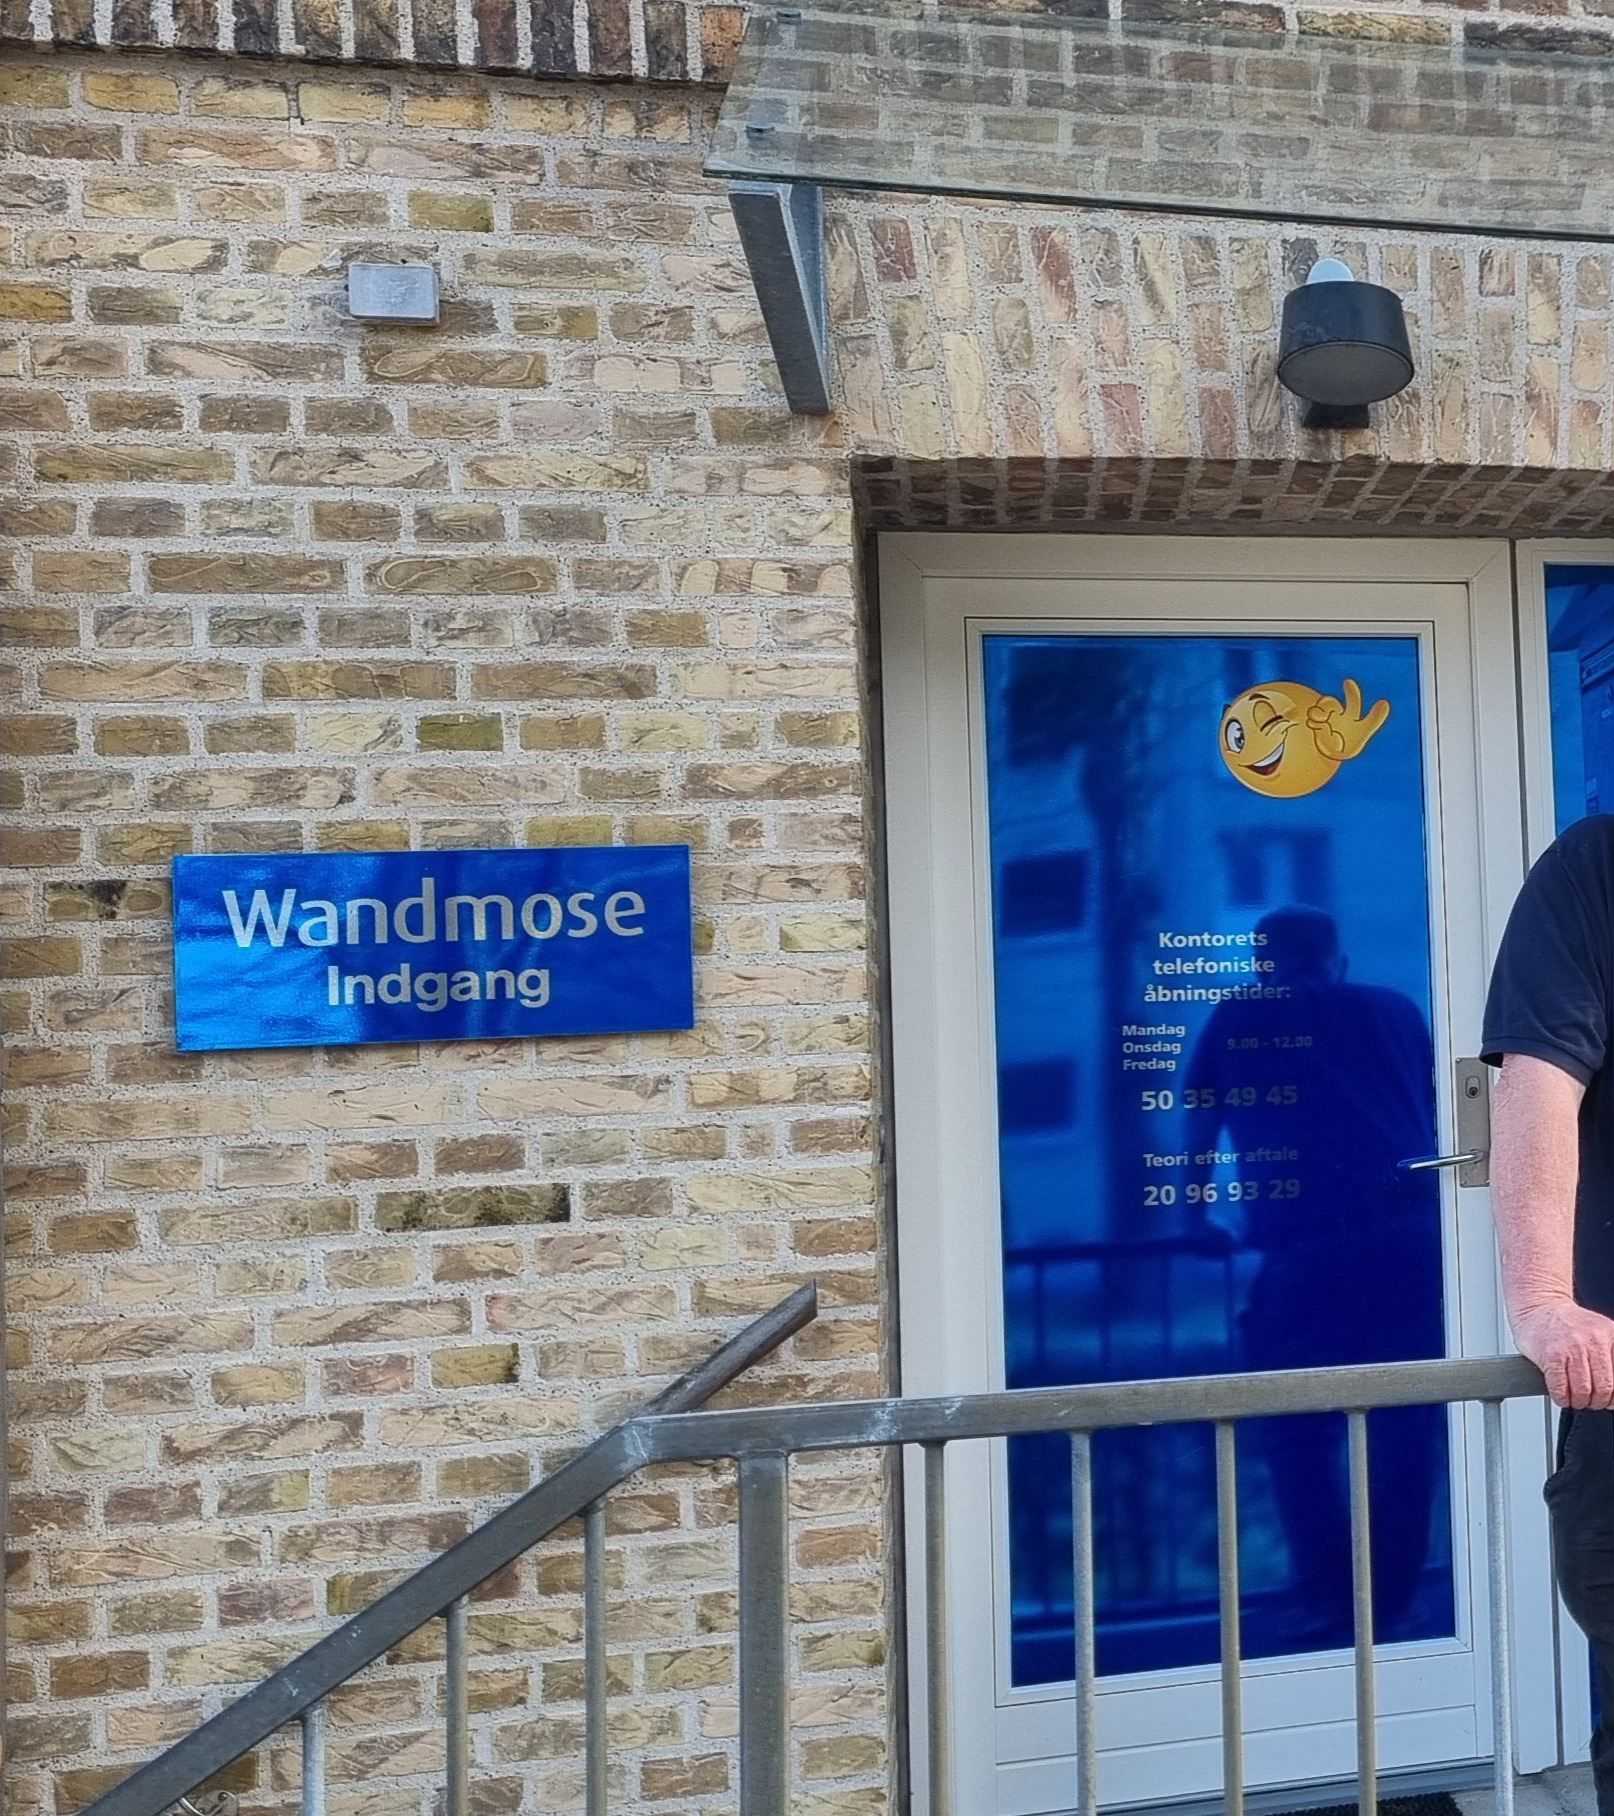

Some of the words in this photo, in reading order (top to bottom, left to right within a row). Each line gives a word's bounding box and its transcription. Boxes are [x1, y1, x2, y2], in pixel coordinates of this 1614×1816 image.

[222, 877, 645, 948] Wandmose
[1158, 931, 1268, 948] Kontorets
[1153, 956, 1275, 976] telefoniske
[327, 963, 551, 1013] Indgang
[1144, 983, 1292, 1005] åbningstider:
[1121, 1024, 1186, 1038] Mandag
[1122, 1041, 1182, 1055] Onsdag
[1273, 1035, 1314, 1048] 12.00
[1122, 1058, 1177, 1072] Fredag
[1141, 1090, 1174, 1111] 50
[1183, 1088, 1216, 1109] 35
[1224, 1086, 1257, 1107] 49
[1265, 1085, 1298, 1106] 45
[1143, 1152, 1189, 1168] Teori
[1194, 1150, 1240, 1166] efter
[1245, 1147, 1299, 1163] aftale
[1143, 1185, 1177, 1206] 20
[1185, 1182, 1218, 1203] 96
[1227, 1180, 1259, 1202] 93
[1268, 1178, 1301, 1200] 29
